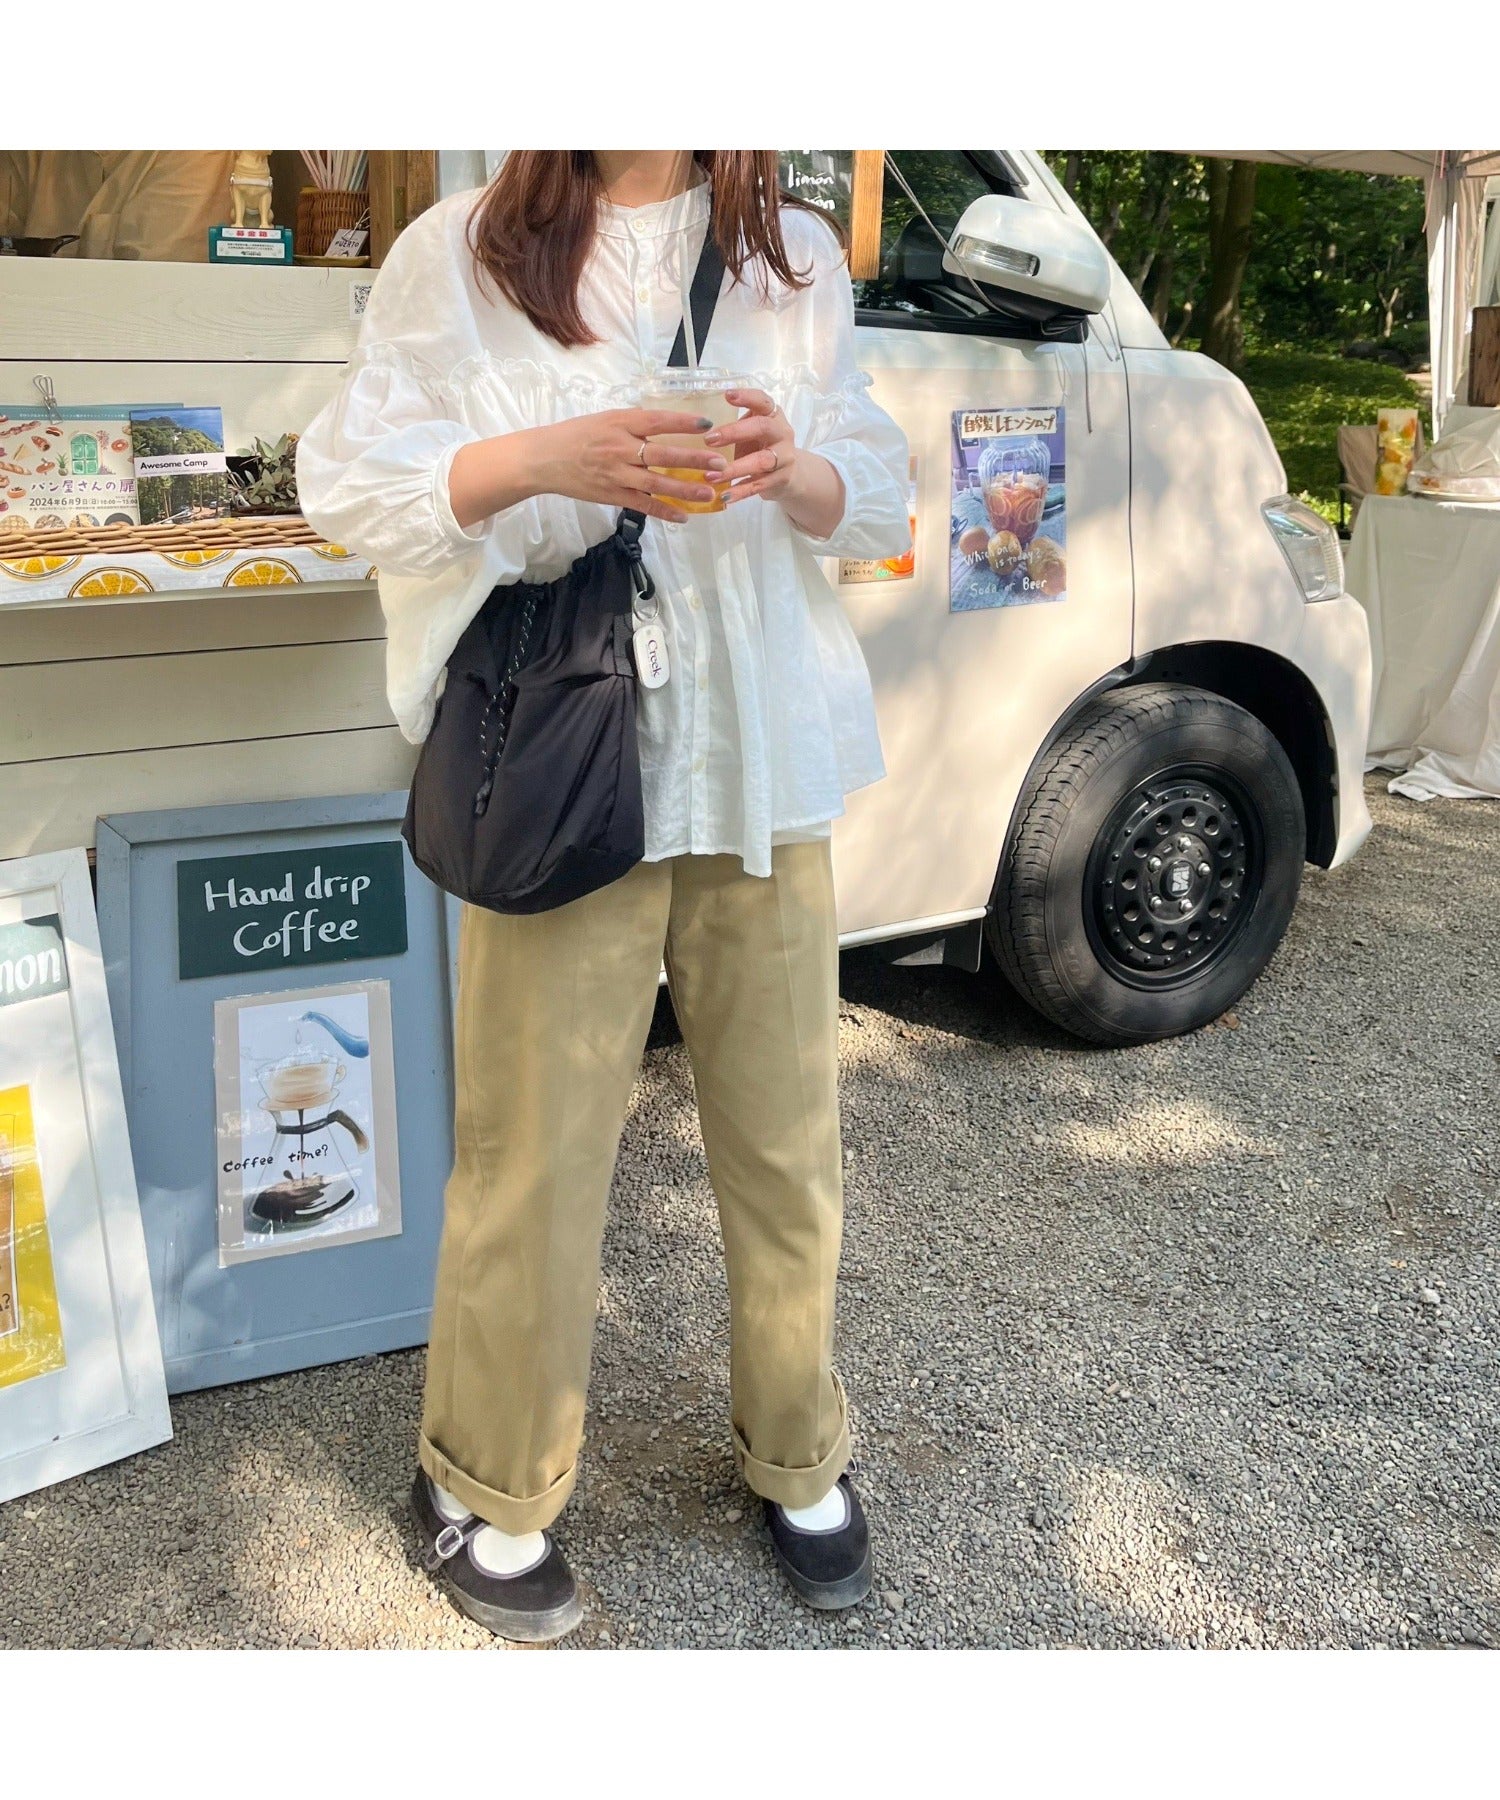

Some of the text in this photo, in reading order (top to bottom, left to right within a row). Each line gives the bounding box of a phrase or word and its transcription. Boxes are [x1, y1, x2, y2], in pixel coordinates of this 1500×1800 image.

[140, 459, 208, 470] Awesome Camp
[964, 549, 995, 565] Which
[995, 559, 1004, 569] is
[970, 582, 998, 597] Soda
[1022, 577, 1048, 591] Beer
[648, 639, 662, 678] Creek
[204, 865, 371, 912] Hand drip
[233, 908, 360, 957] Coffee
[288, 1144, 329, 1162] time?
